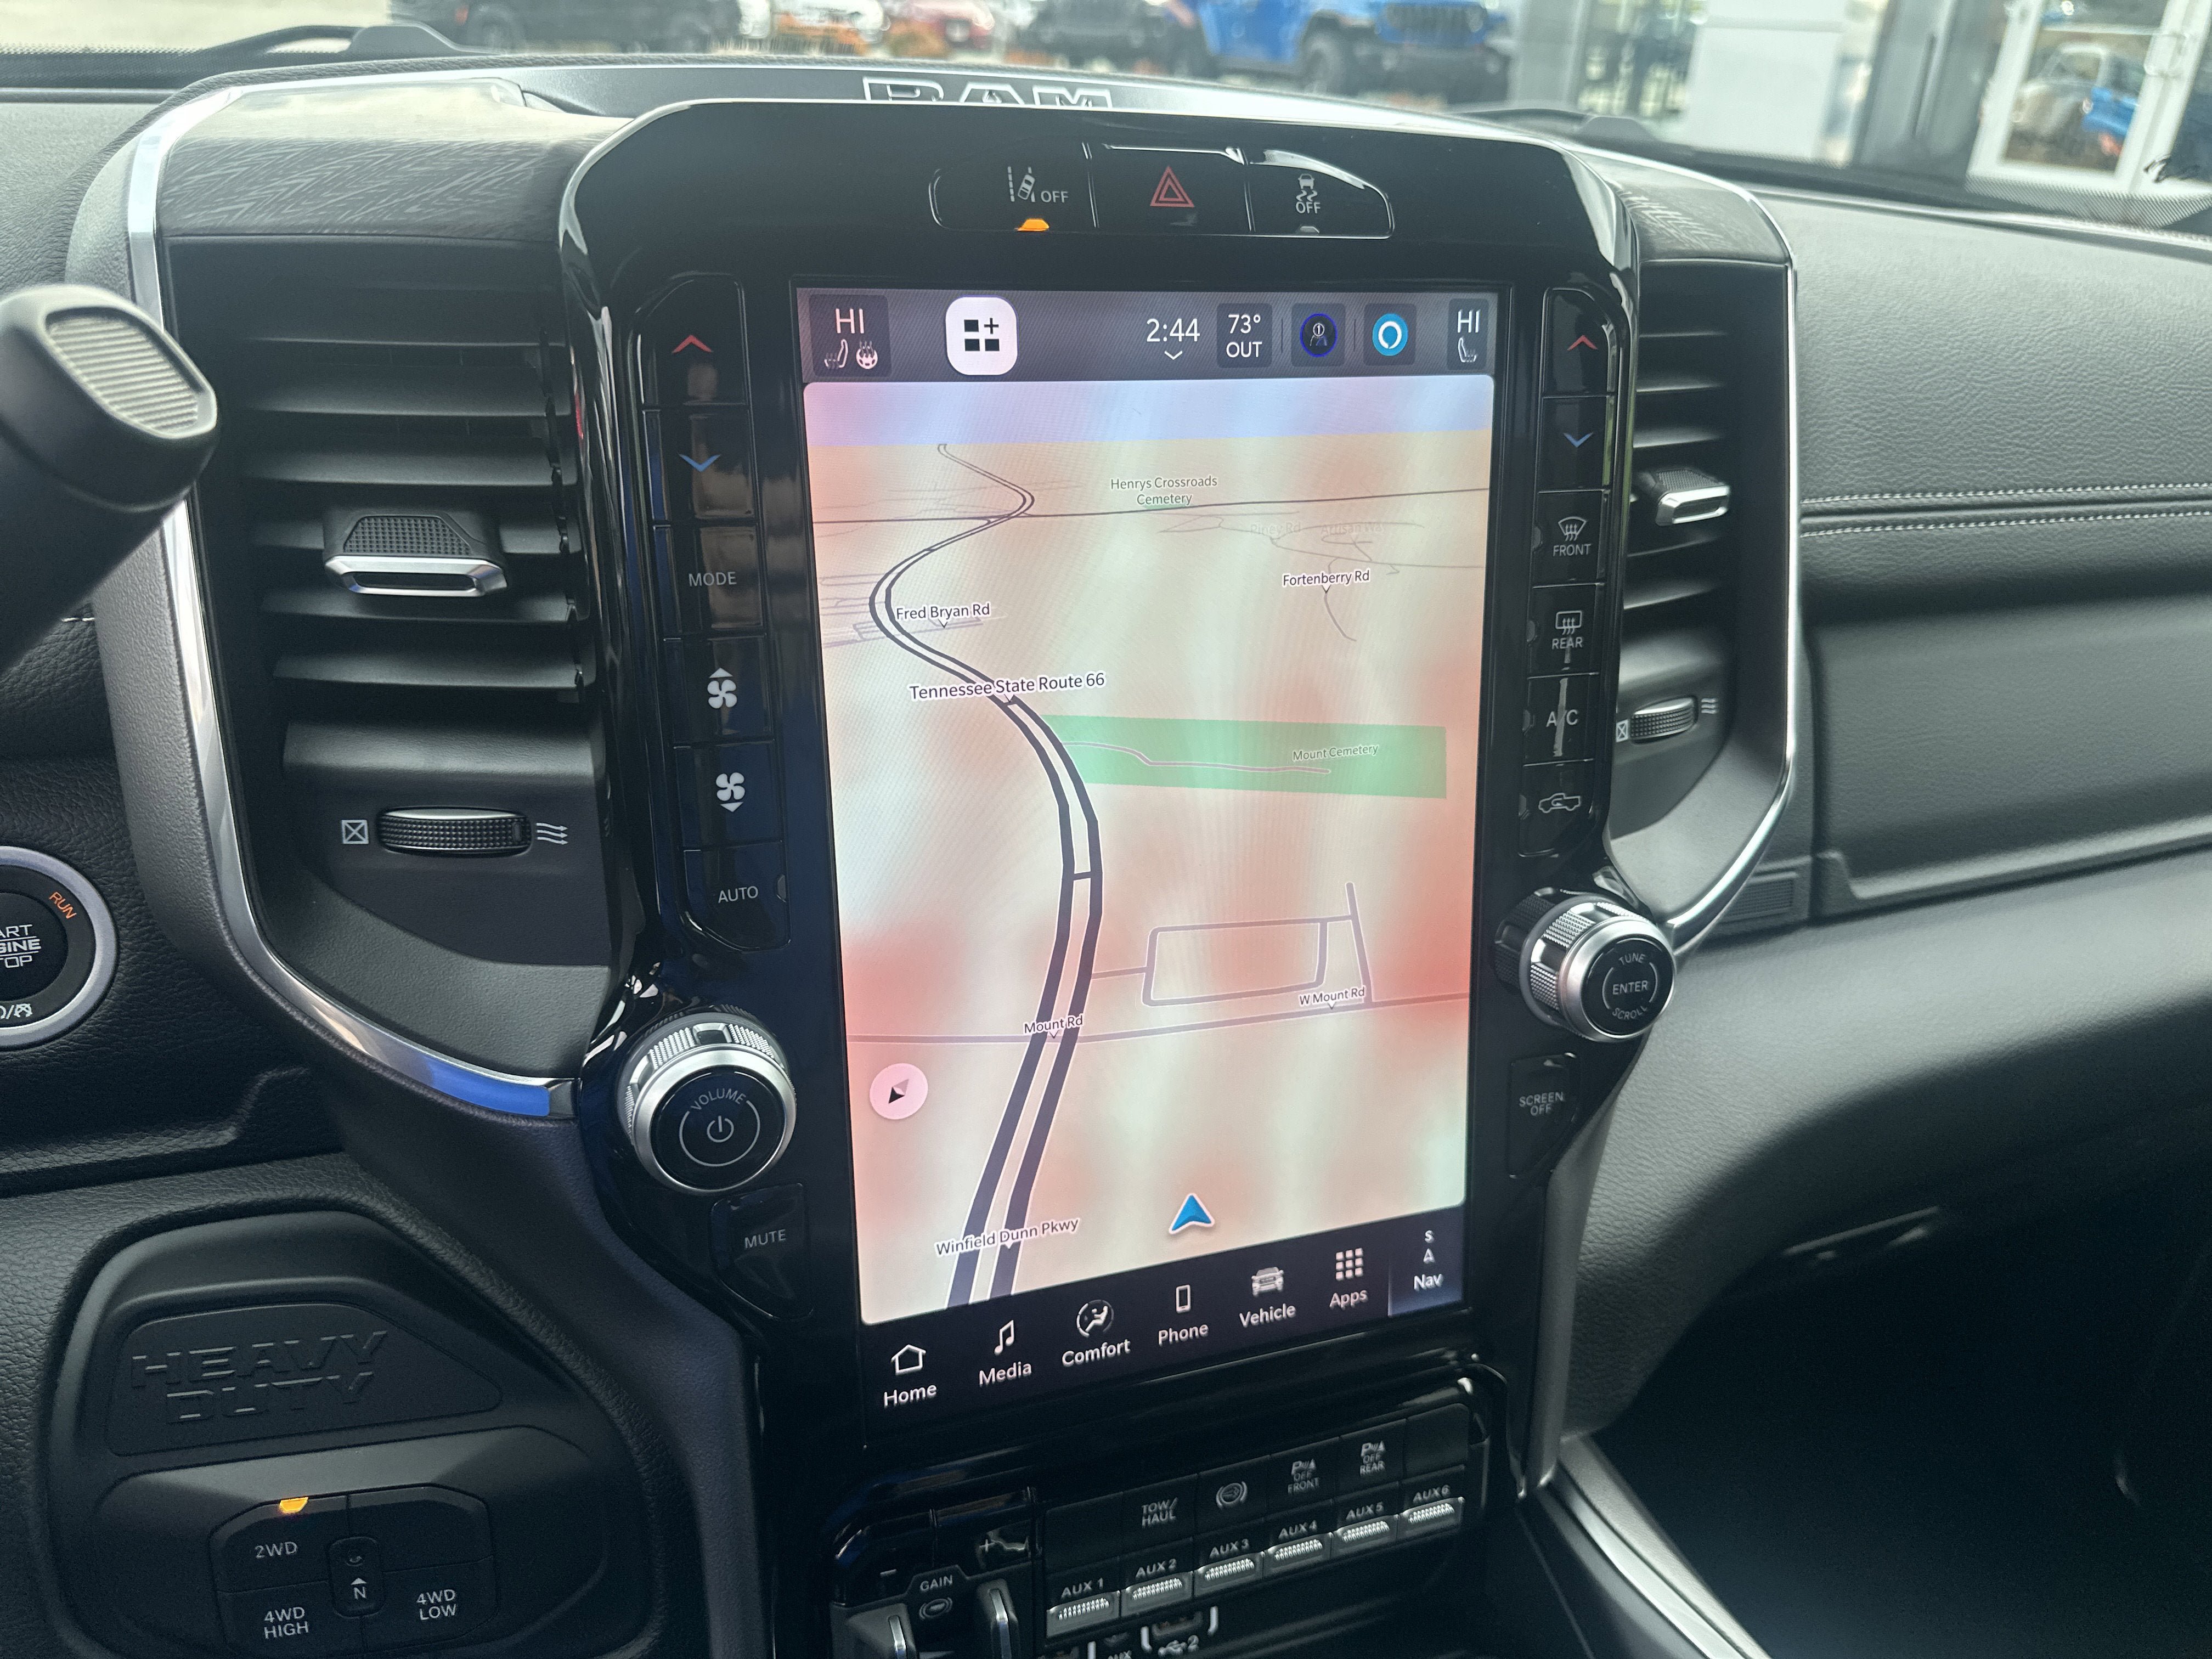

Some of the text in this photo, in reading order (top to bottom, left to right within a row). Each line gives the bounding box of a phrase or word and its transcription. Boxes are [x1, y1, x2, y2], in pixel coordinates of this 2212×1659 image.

[1041, 190, 1069, 204] OFF
[1295, 201, 1321, 215] OFF
[835, 307, 865, 334] HI
[1228, 314, 1262, 334] 73°
[1457, 310, 1480, 334] HI
[1146, 318, 1201, 343] 2:44
[1226, 341, 1263, 358] OUT
[1111, 475, 1218, 491] Henrys Crossroads
[1137, 494, 1193, 506] Cemetery
[1553, 543, 1592, 557] FRONT
[688, 571, 737, 587] MODE
[1283, 569, 1370, 586] Fortenberry Rd
[896, 603, 990, 620] Fred Bryan Rd
[1551, 636, 1583, 650] REAR
[909, 673, 1105, 699] Tennessee State Route 66
[1293, 745, 1379, 761] Mount Cemetery
[717, 885, 759, 904] AUTO
[48, 891, 77, 919] RUN
[1618, 952, 1646, 966] TUNE
[1300, 986, 1365, 1005] W Mount Rd
[1612, 980, 1649, 995] ENTER
[1611, 1004, 1647, 1020] SCROLL
[1024, 1014, 1083, 1034] Mount Rd
[691, 1087, 747, 1112] VOLUME
[1519, 1091, 1565, 1108] SCREEN
[1530, 1103, 1553, 1117] OFF
[744, 1229, 786, 1249] MUTE
[936, 1217, 1079, 1256] Winfield Dunn Pkwy
[1413, 1272, 1443, 1291] Nav
[1329, 1287, 1368, 1310] Apps
[1239, 1302, 1296, 1328] Vehicle
[1158, 1322, 1209, 1347] Phone
[131, 1330, 388, 1389] HEAVY
[1062, 1338, 1131, 1367] Comfort
[978, 1360, 1032, 1387] Media
[167, 1372, 373, 1425] DUTY
[883, 1383, 938, 1409] Home
[1360, 1460, 1386, 1477] REAR
[1288, 1477, 1320, 1494] FRONT
[1413, 1485, 1451, 1504] AUX 6
[1142, 1511, 1177, 1528] HAUL
[1346, 1502, 1385, 1521] AUX 5
[1278, 1520, 1317, 1541] AUX 4
[255, 1541, 298, 1559] 2WD
[1209, 1539, 1249, 1560] AUX 3
[1135, 1558, 1177, 1581] AUX 2
[353, 1586, 366, 1600] N
[919, 1575, 953, 1593] GAIN
[1061, 1577, 1104, 1599] AUX 1
[417, 1589, 456, 1606] 4WD
[264, 1606, 306, 1624] 4WD
[419, 1603, 458, 1621] LOW
[263, 1621, 309, 1640] HIGH
